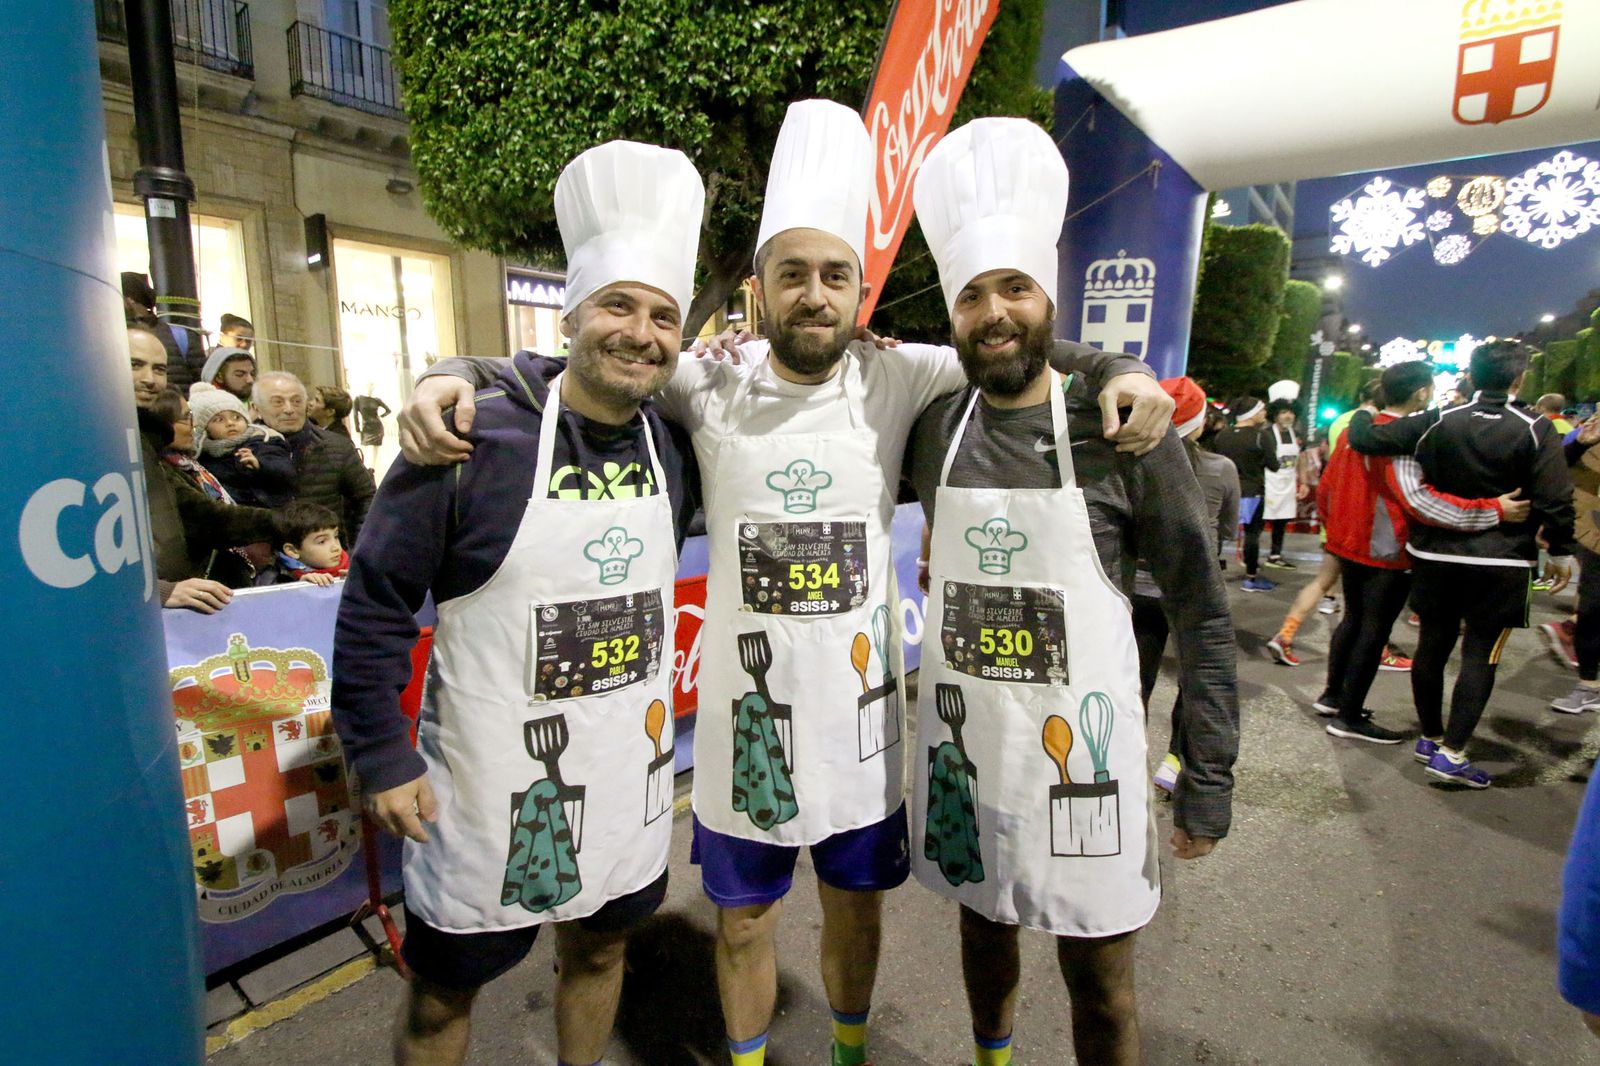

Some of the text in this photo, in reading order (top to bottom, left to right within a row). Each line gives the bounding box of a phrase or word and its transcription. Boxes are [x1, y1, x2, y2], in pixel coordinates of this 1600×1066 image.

[341, 300, 421, 321] MANGO
[19, 428, 155, 603] caj
[788, 562, 840, 590] 534
[591, 634, 640, 668] 532
[979, 628, 1034, 656] 530
[609, 664, 626, 676] PABLO
[995, 656, 1020, 667] MANUEL
[218, 888, 269, 916] CIUDAD
[270, 880, 287, 894] DE
